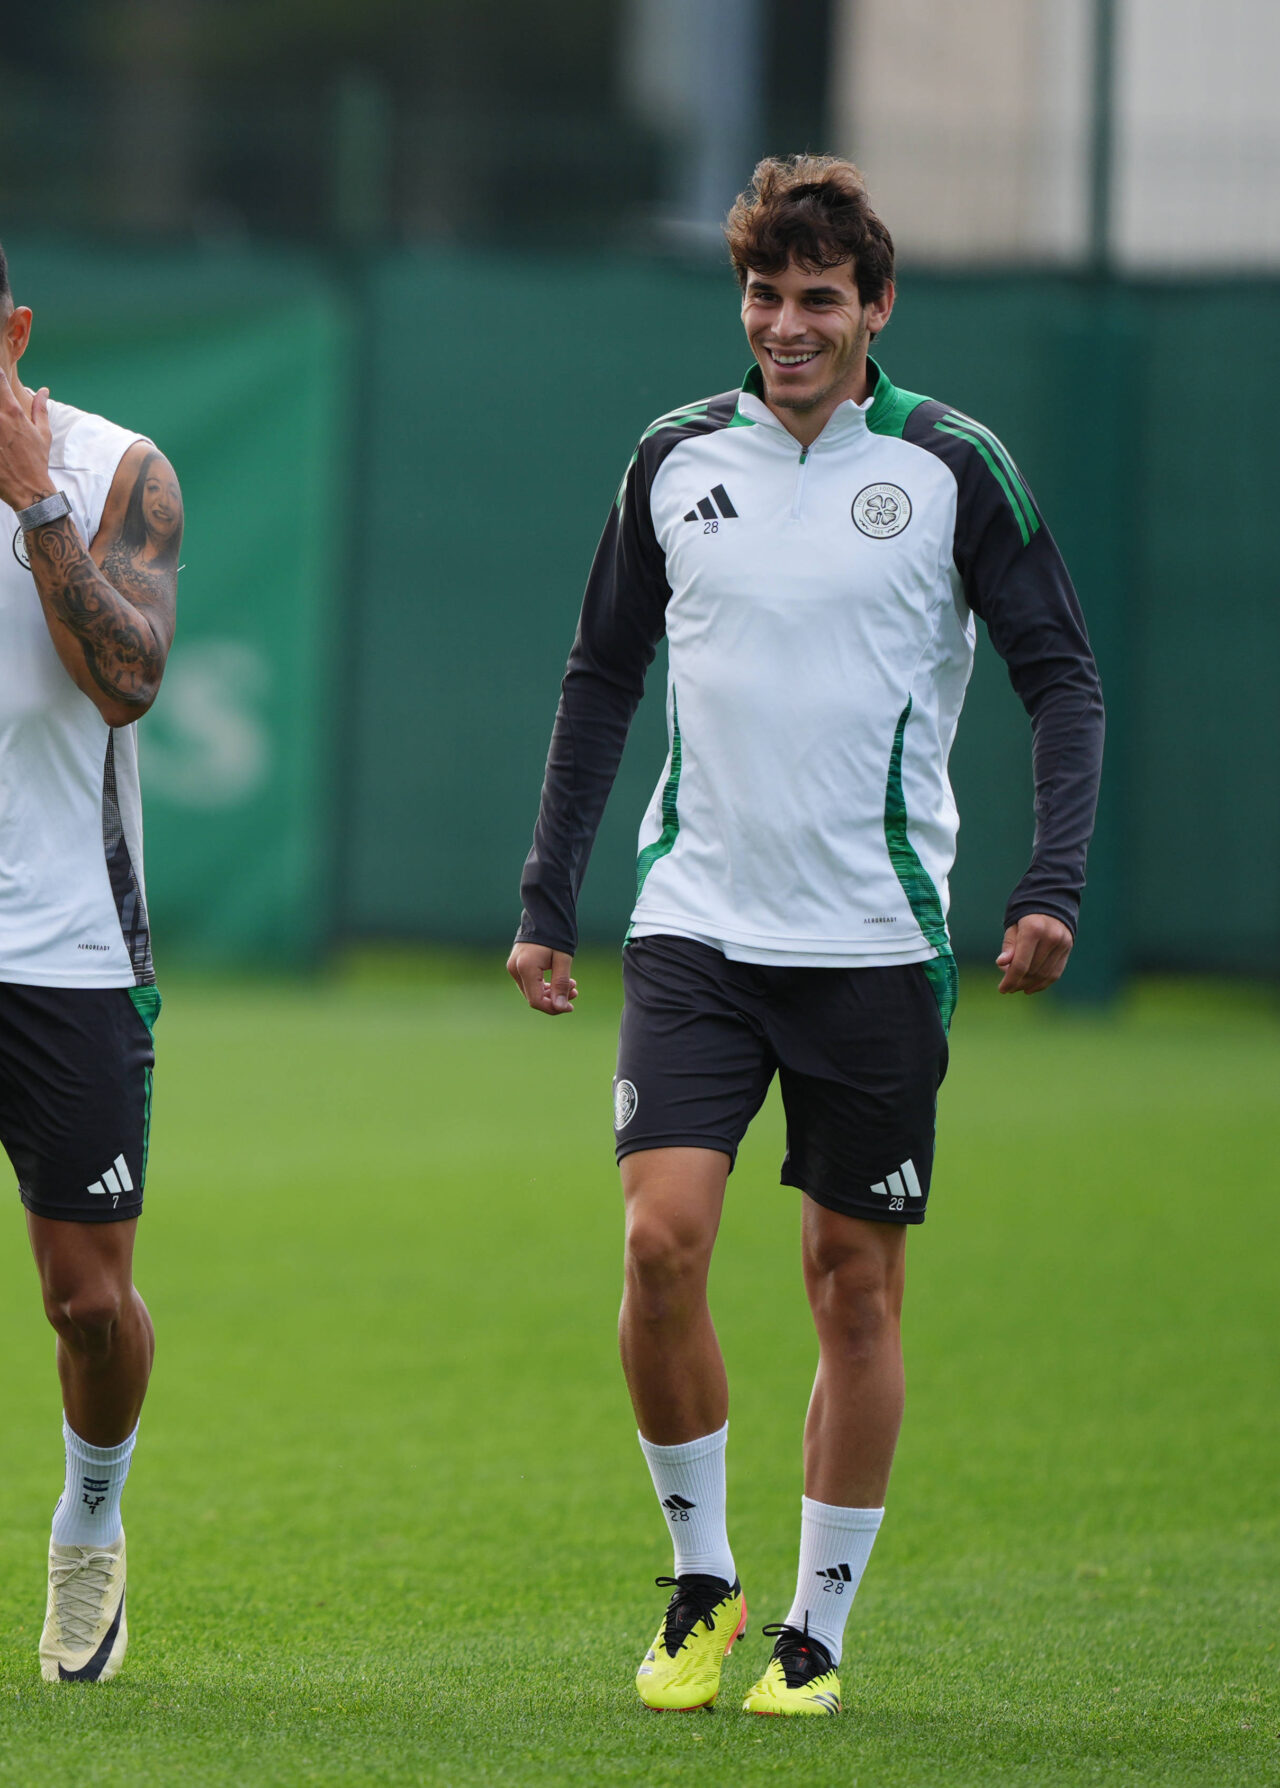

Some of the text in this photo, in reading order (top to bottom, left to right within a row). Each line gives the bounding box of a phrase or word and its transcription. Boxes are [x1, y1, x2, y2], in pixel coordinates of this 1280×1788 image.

[703, 521, 719, 535] 28
[863, 916, 897, 924] AEROREADY
[77, 943, 111, 951] AEROREADY
[112, 1195, 119, 1209] 7
[888, 1197, 905, 1211] 28
[82, 1493, 106, 1506] LP
[89, 1505, 96, 1515] 7
[669, 1510, 690, 1523] 28
[823, 1579, 845, 1595] 28
